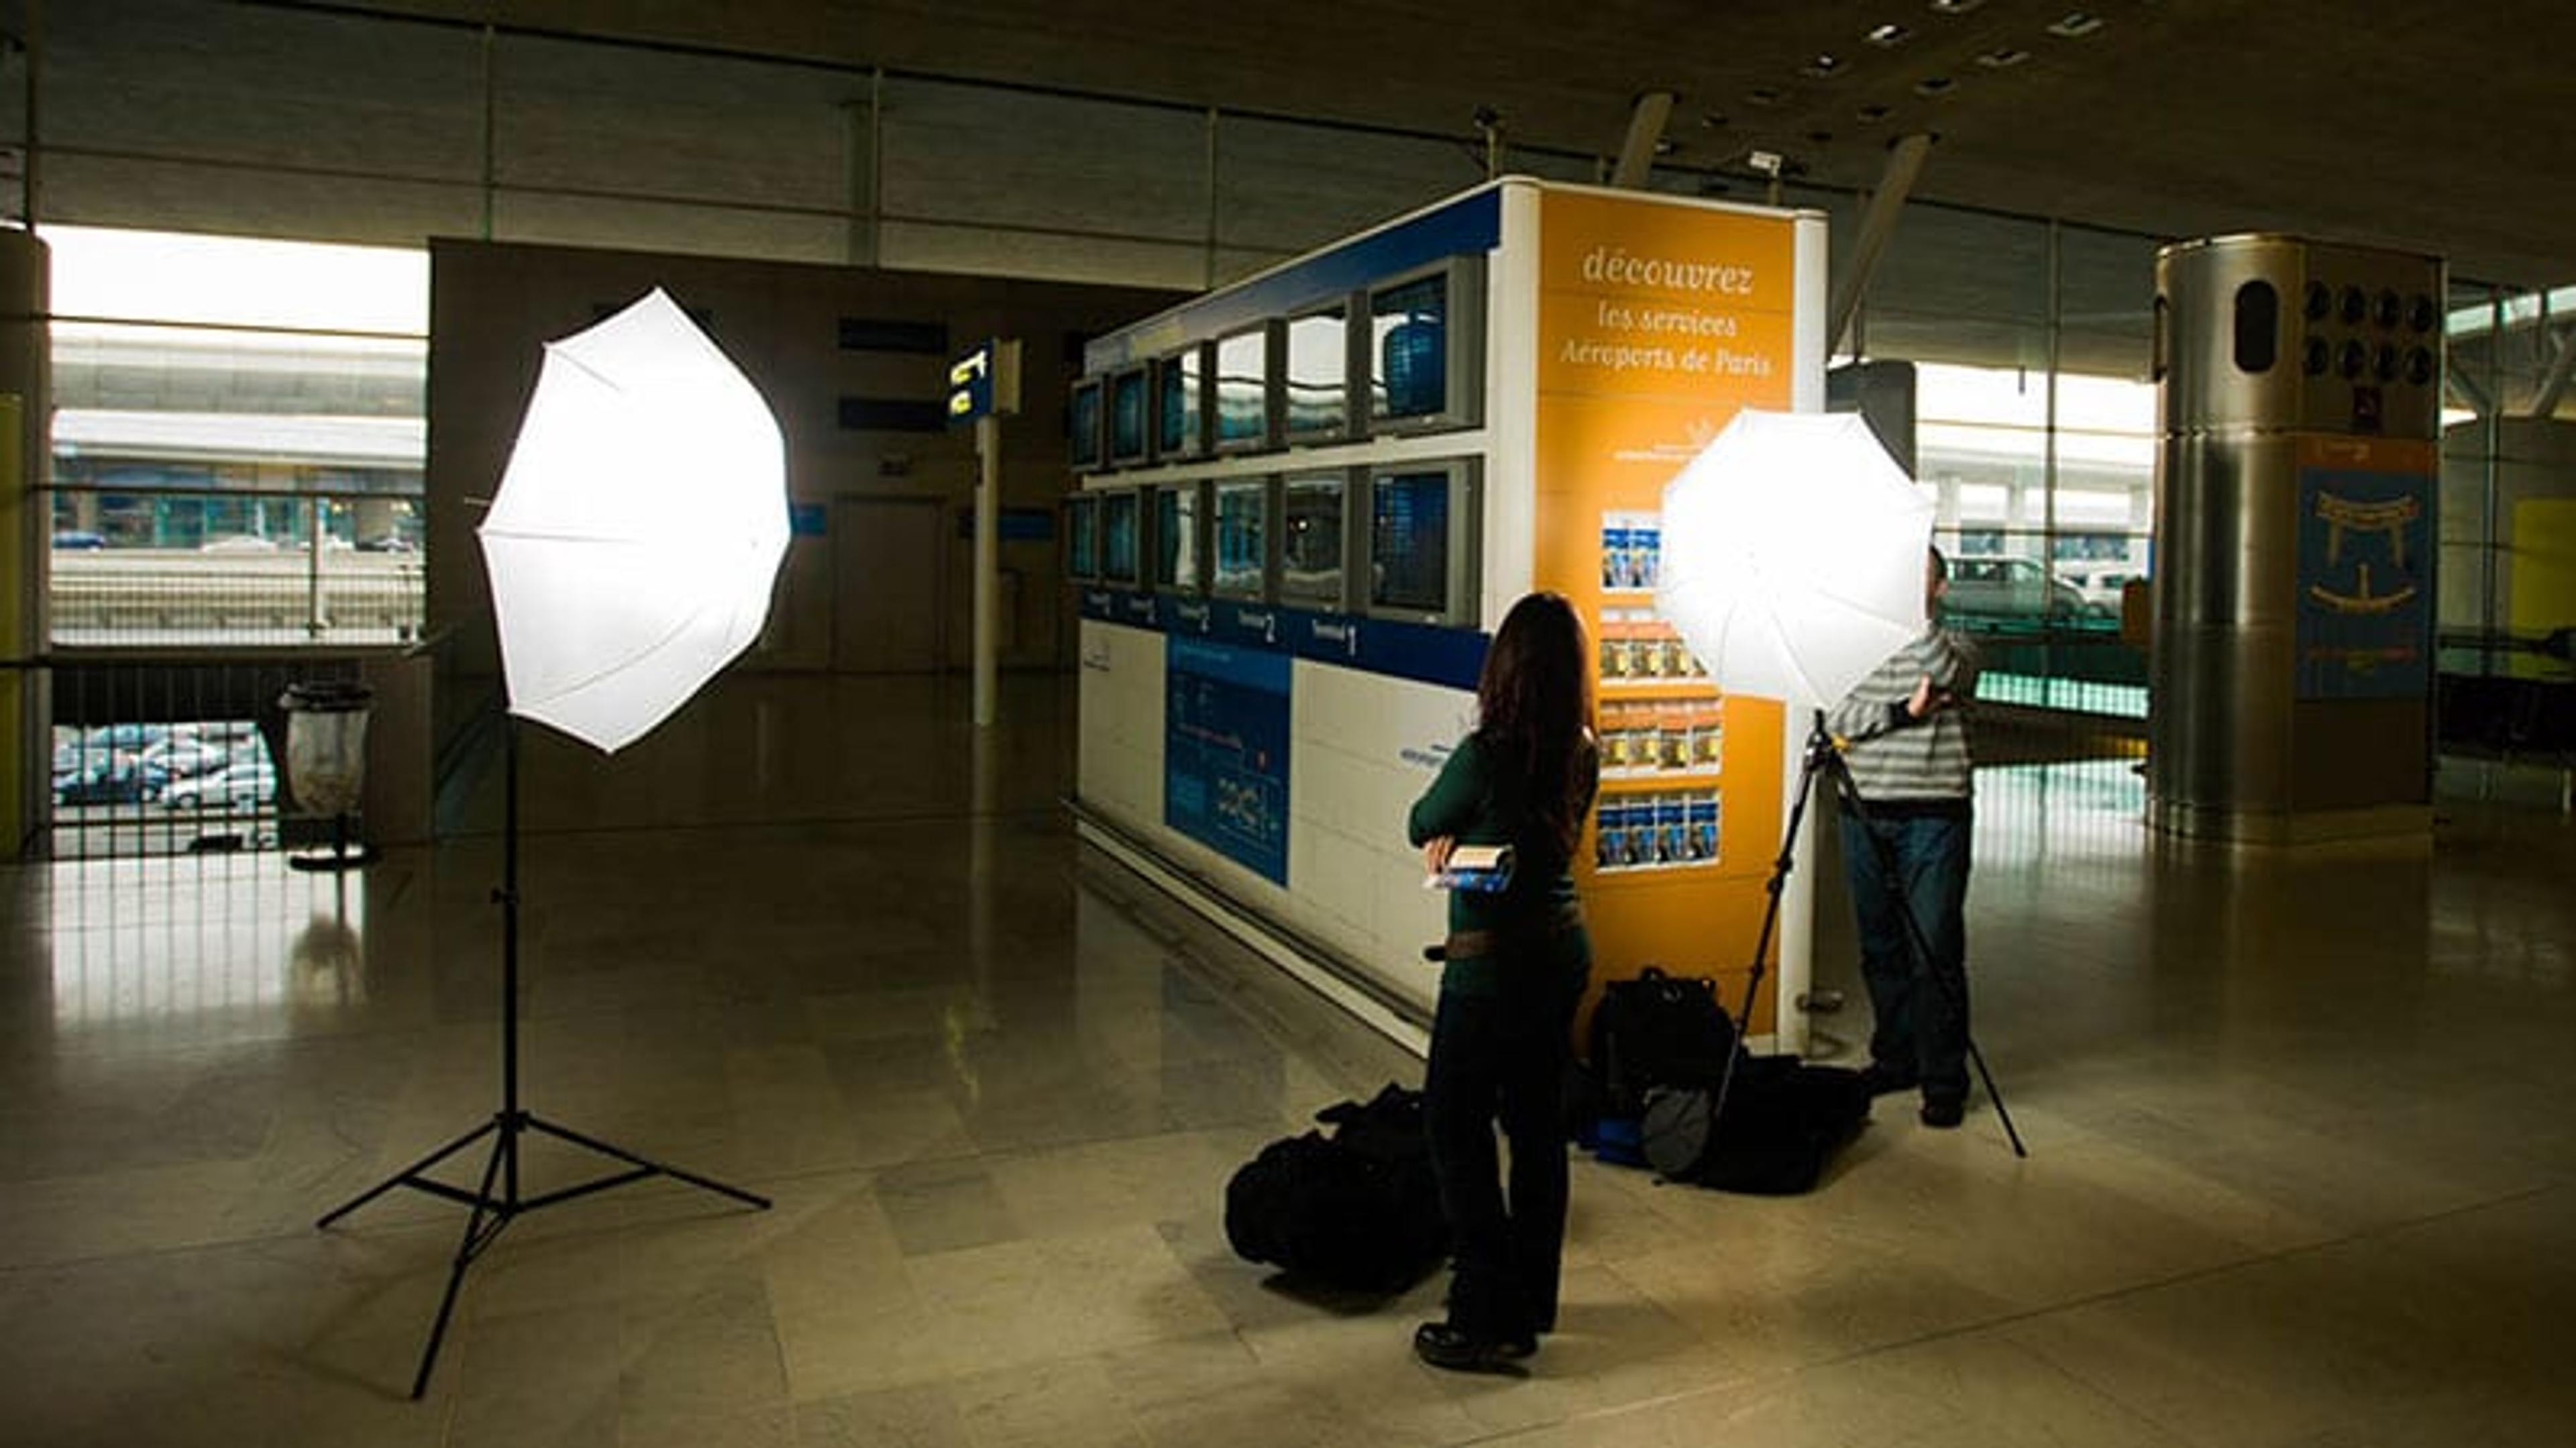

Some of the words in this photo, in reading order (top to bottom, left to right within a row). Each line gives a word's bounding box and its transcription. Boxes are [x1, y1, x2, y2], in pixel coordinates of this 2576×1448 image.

[1582, 246, 1754, 295] découvrez
[1598, 300, 1633, 330] les
[1639, 308, 1737, 337] services
[1680, 347, 1709, 372] de
[1715, 347, 1772, 377] Paris
